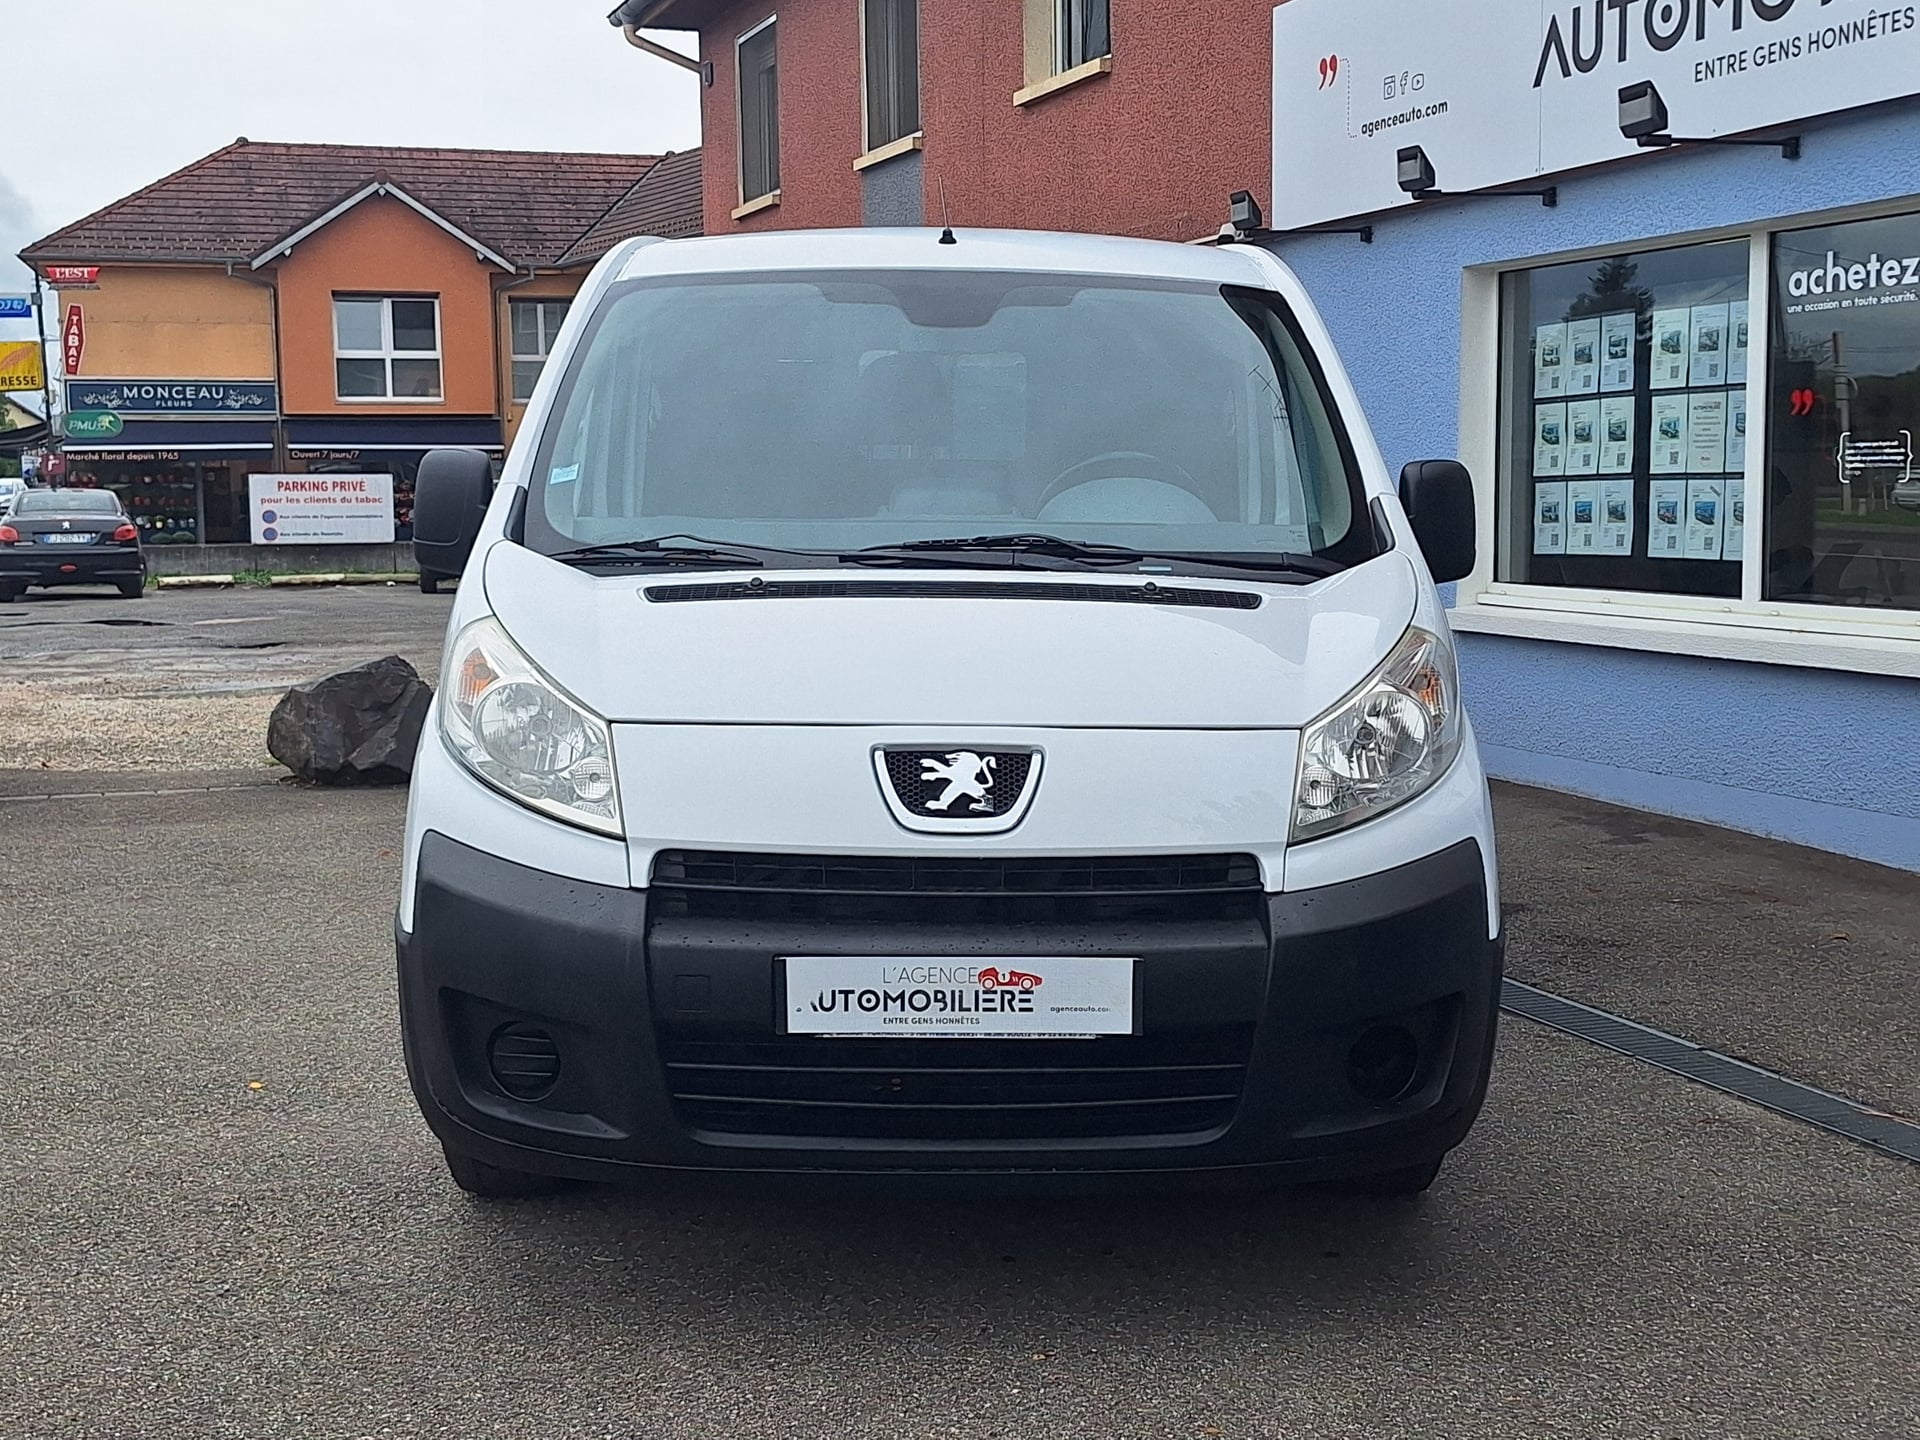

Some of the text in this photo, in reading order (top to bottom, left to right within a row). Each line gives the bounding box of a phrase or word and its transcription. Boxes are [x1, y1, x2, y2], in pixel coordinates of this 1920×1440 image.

[1532, 0, 1833, 88] AUTOM
[1694, 6, 1915, 83] ENTRE GENS HONNÊTES
[1361, 101, 1448, 137] agenceauto.com
[1788, 250, 1920, 297] achetez
[1786, 305, 1802, 313] une
[1804, 299, 1839, 312] occasion
[1841, 299, 1852, 308] en
[1854, 296, 1878, 306] toute
[67, 315, 80, 366] TABAC
[123, 386, 224, 399] MONCEAU
[155, 400, 194, 408] FLEURS
[69, 420, 97, 431] PMU
[66, 452, 99, 461] Marché
[127, 452, 155, 462] depuis
[158, 452, 179, 460] 1965
[291, 450, 320, 459] Ouvert
[321, 450, 328, 458] 7
[277, 478, 366, 492] PARKING PRIVÉ
[260, 495, 384, 506] pour les clients du tabac
[882, 966, 979, 984] L'AGENCE
[797, 989, 1035, 1013] UTOMOBILIERE
[883, 1015, 981, 1025] ENTRE GENS HONNÊTES
